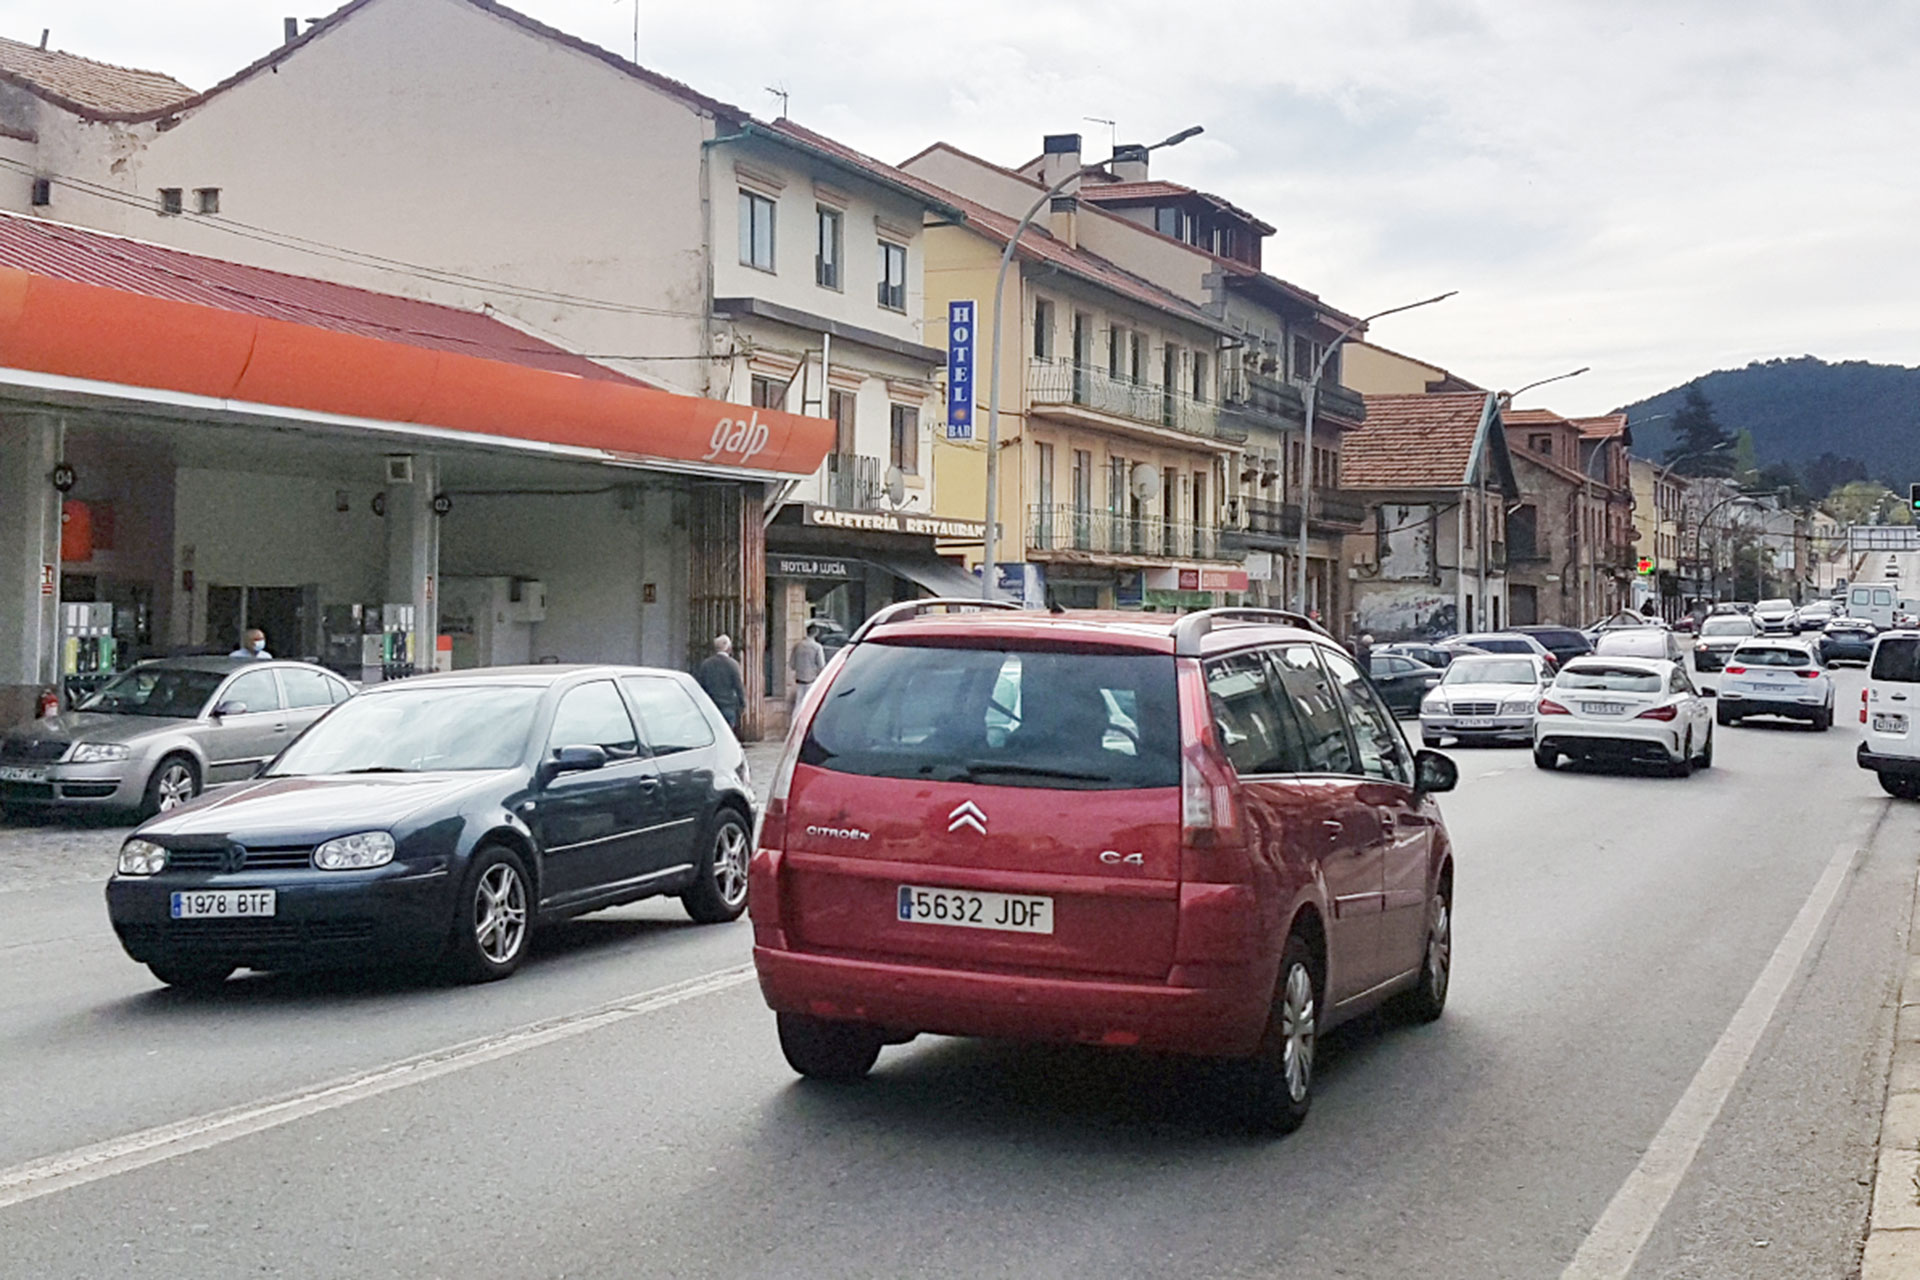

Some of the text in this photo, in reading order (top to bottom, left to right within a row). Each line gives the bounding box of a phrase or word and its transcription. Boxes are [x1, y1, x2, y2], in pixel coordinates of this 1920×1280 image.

[952, 306, 970, 402] HOTEL
[702, 410, 769, 464] galp
[948, 424, 971, 437] BAR
[56, 469, 72, 485] 04
[812, 509, 998, 541] CAFETERÍA RESTAURAN
[780, 560, 812, 573] HOTEL
[806, 825, 871, 840] CITROËN
[1099, 851, 1145, 865] C4
[186, 893, 270, 914] 1978 BTF
[916, 892, 1045, 927] 5632 JDF
